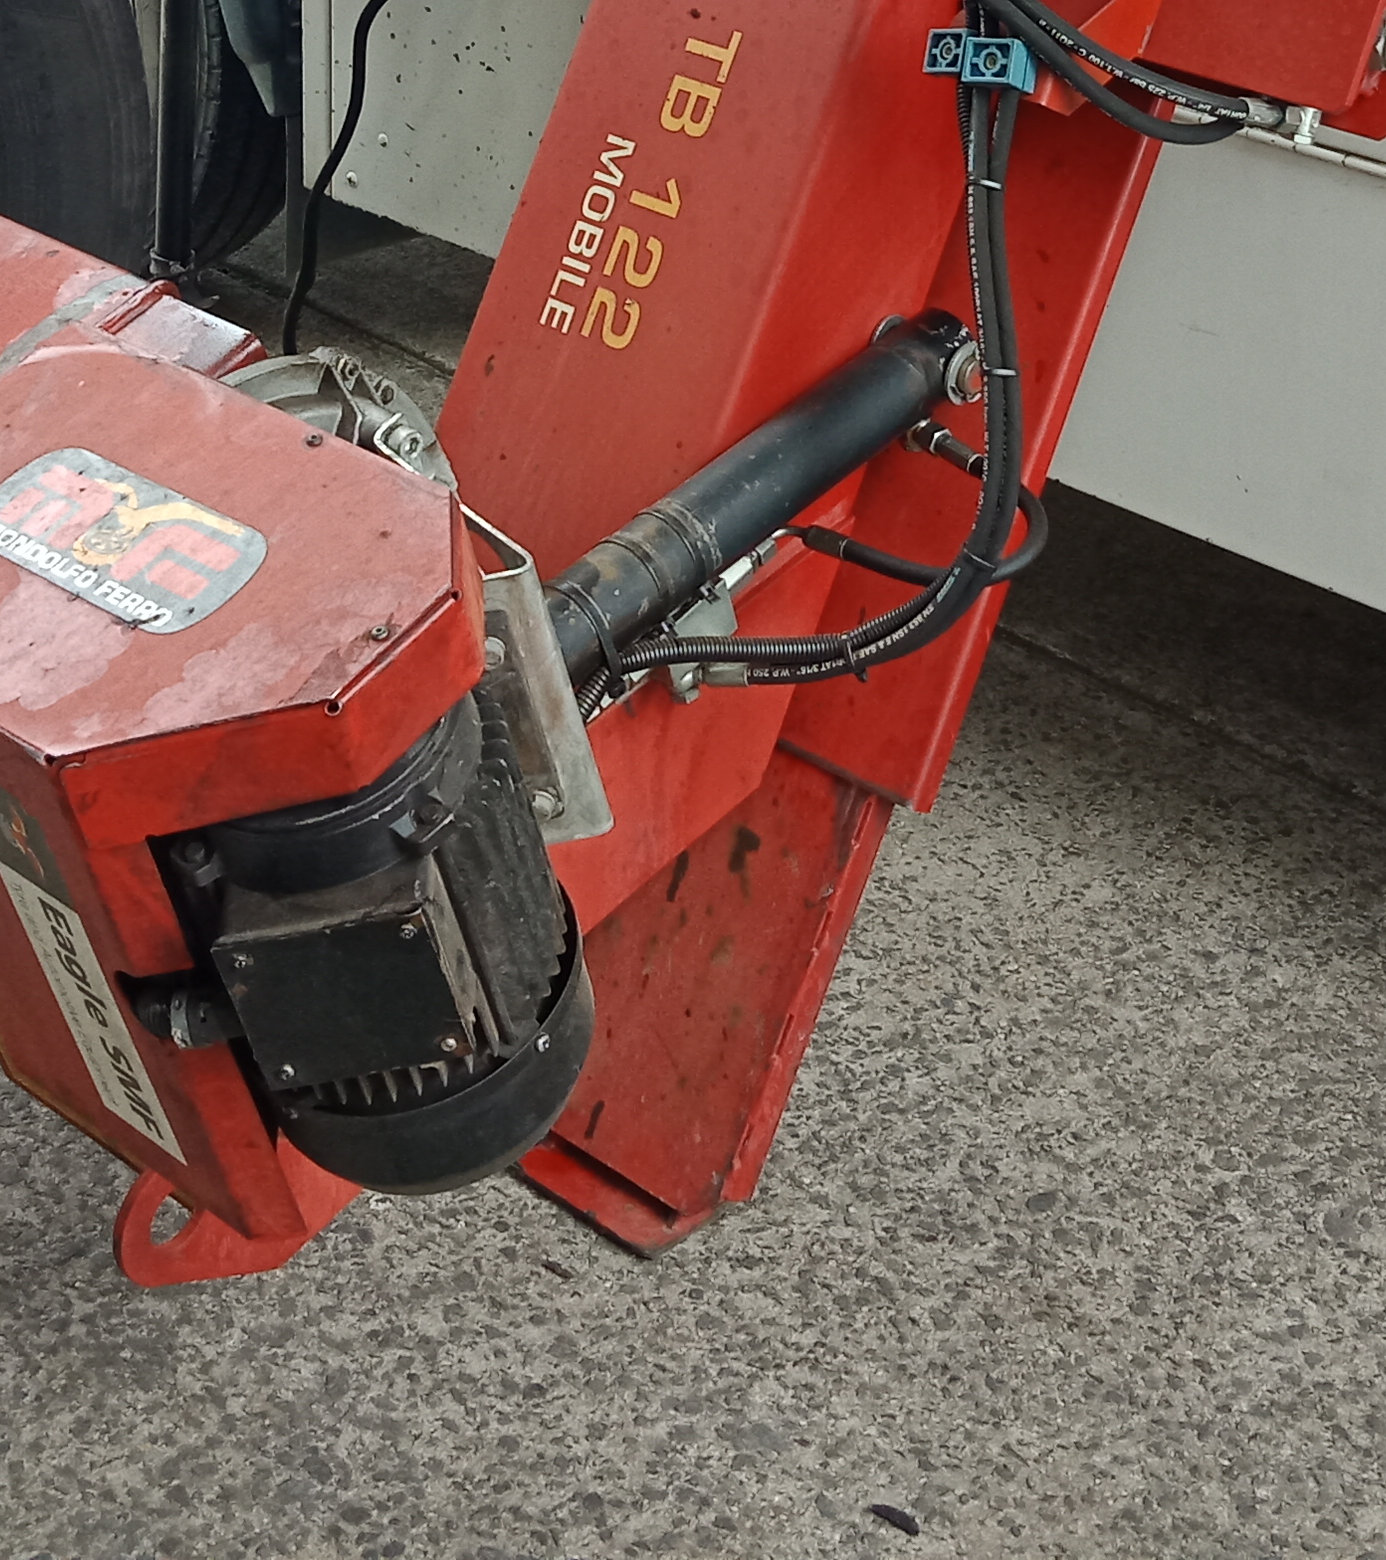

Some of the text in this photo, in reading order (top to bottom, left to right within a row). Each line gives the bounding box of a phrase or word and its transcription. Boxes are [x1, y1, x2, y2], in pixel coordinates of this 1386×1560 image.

[539, 133, 637, 334] MOBILE
[580, 30, 743, 350] TB 122
[95, 580, 173, 627] FERRO
[38, 896, 165, 1141] Eagle SMF
